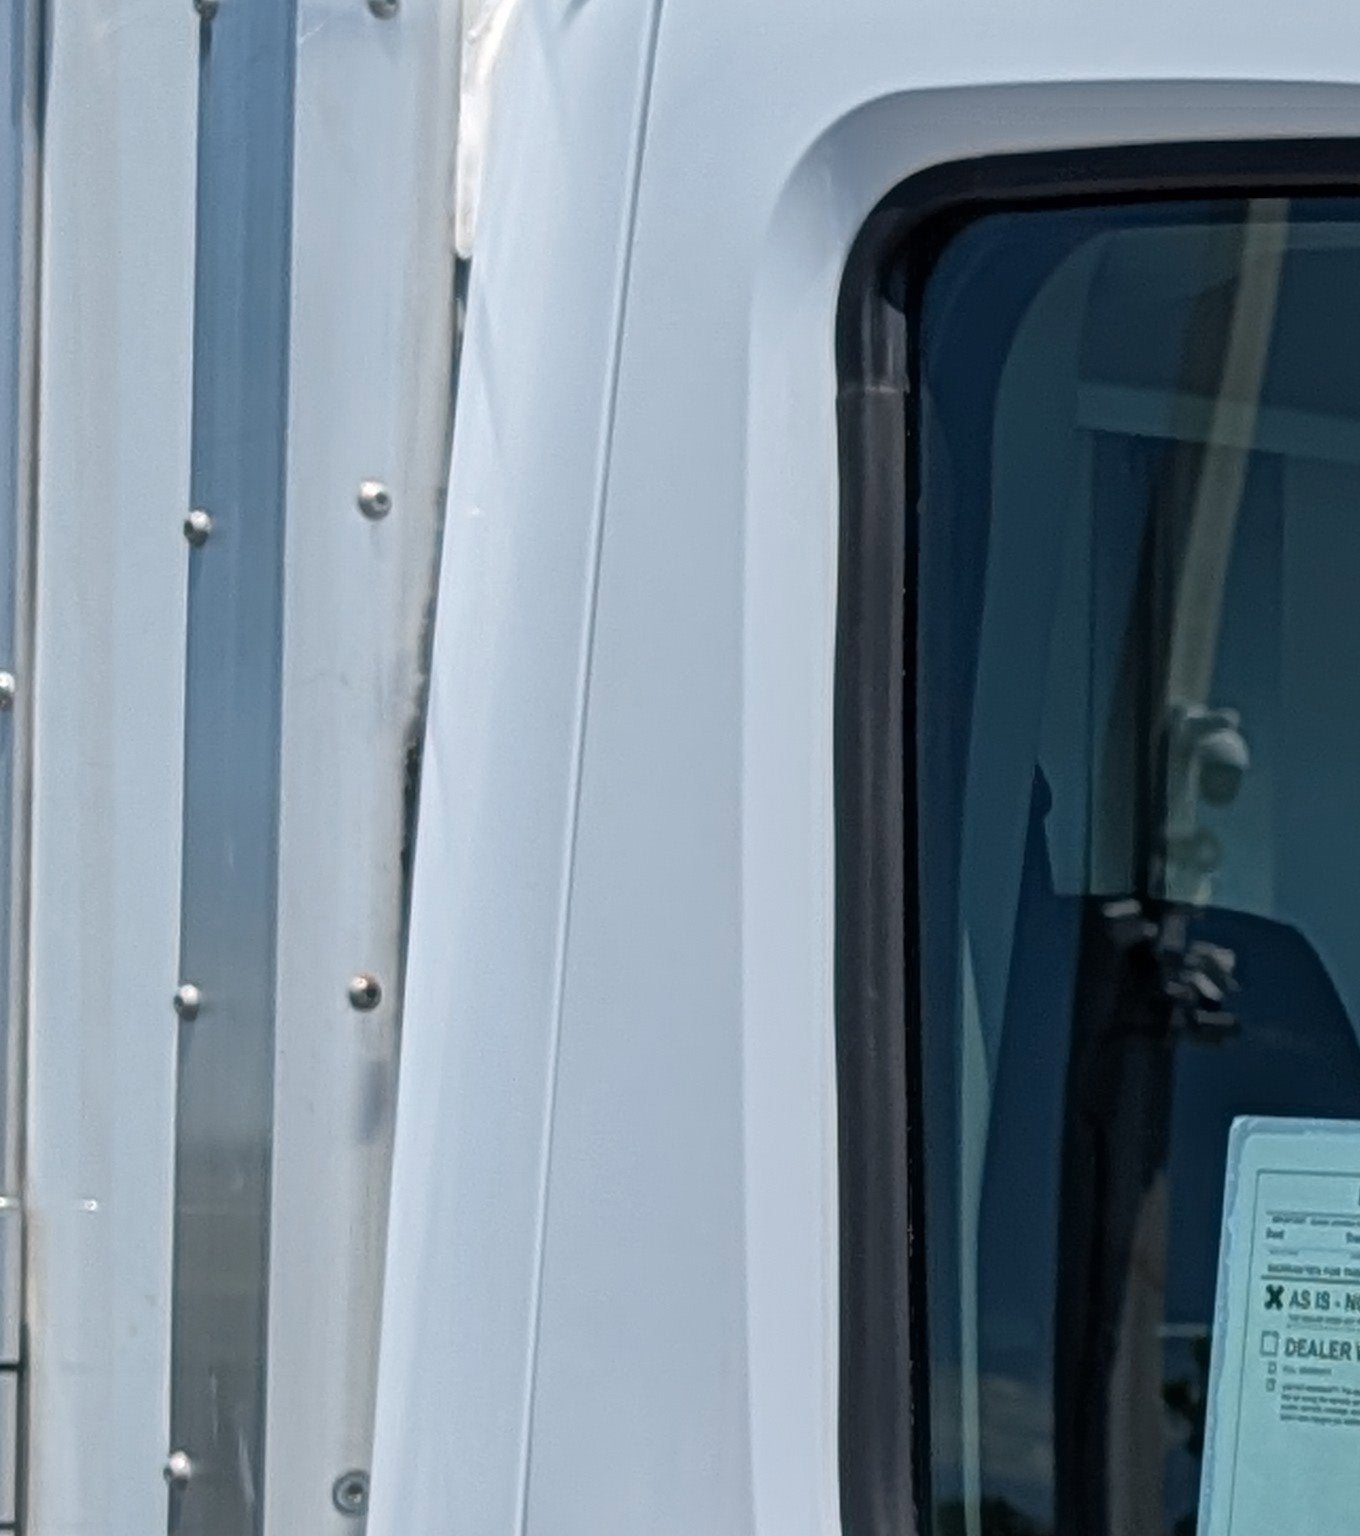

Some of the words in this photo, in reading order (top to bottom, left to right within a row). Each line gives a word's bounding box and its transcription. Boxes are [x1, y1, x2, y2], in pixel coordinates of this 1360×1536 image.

[1289, 1289, 1311, 1310] AS
[1314, 1290, 1331, 1311] IS
[1284, 1337, 1352, 1361] DEALER
